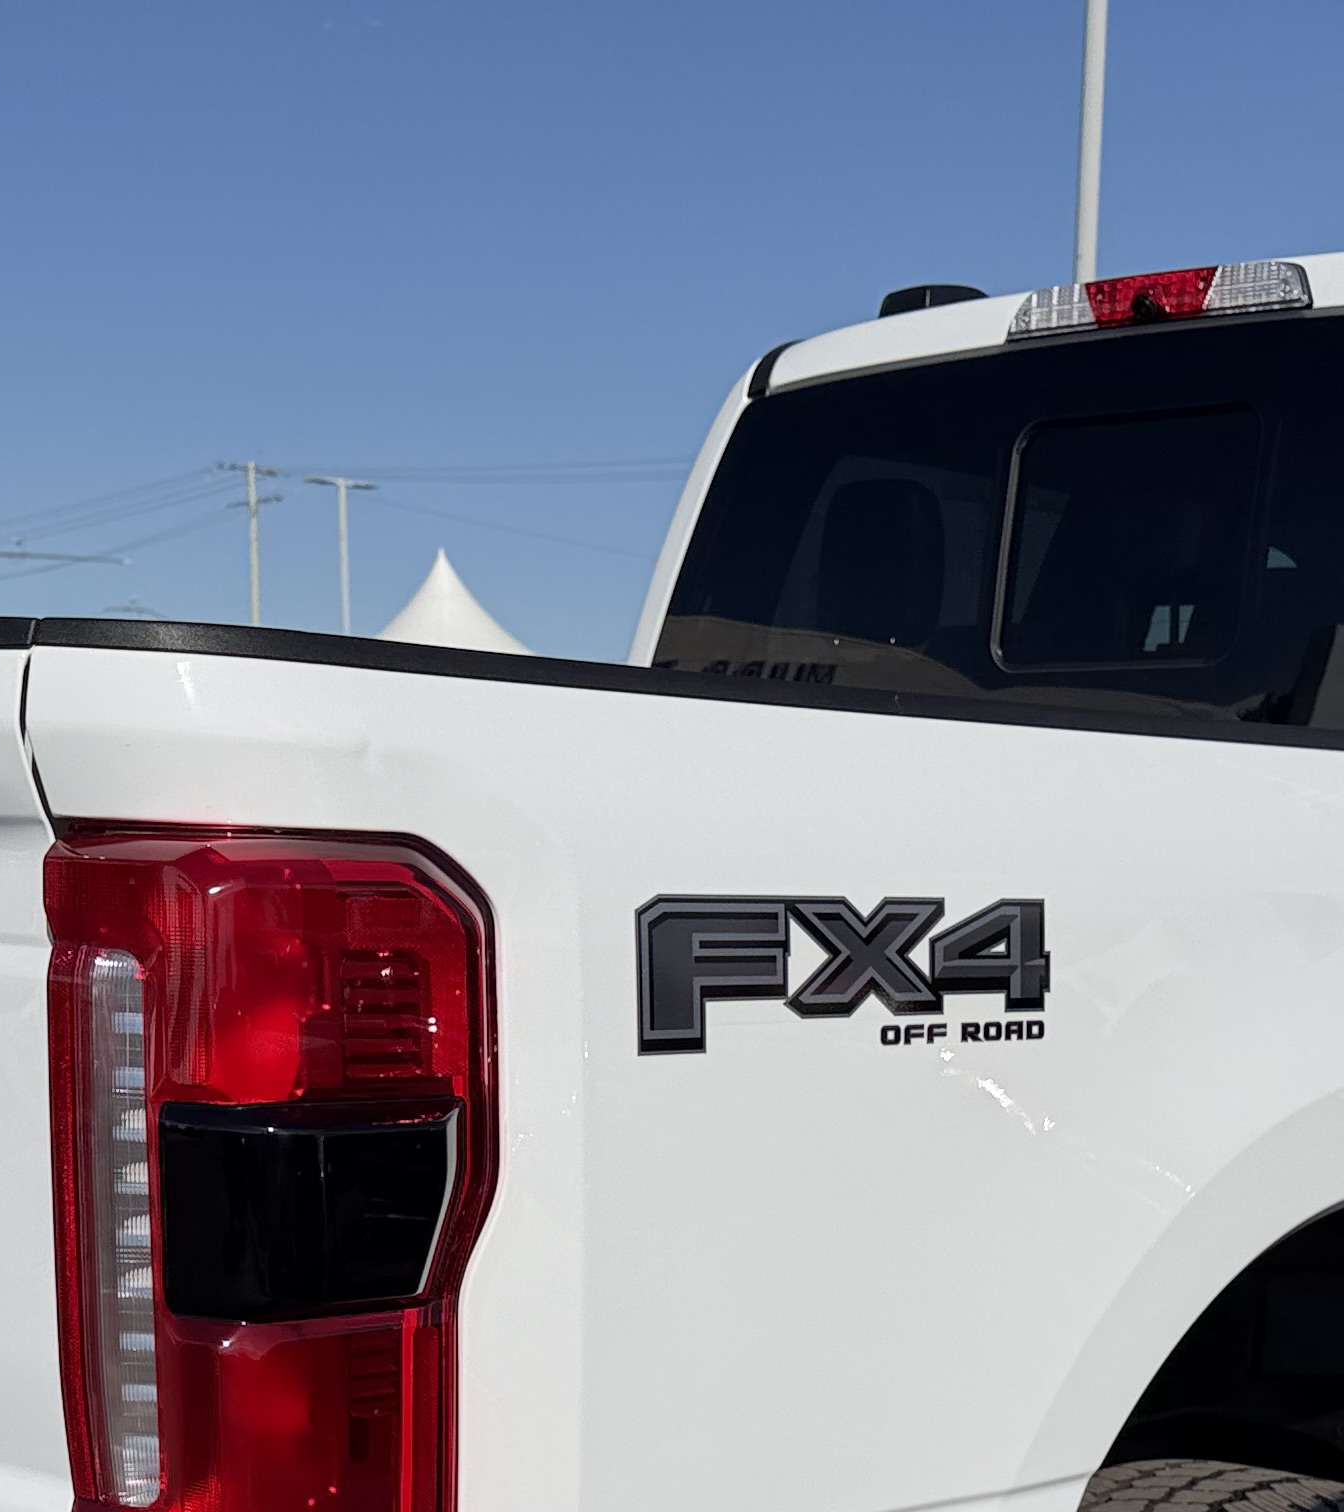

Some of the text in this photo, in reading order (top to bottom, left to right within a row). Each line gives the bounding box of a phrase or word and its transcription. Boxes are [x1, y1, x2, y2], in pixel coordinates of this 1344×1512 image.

[635, 894, 1051, 1056] FX4
[880, 1020, 1046, 1046] OFF ROAD
